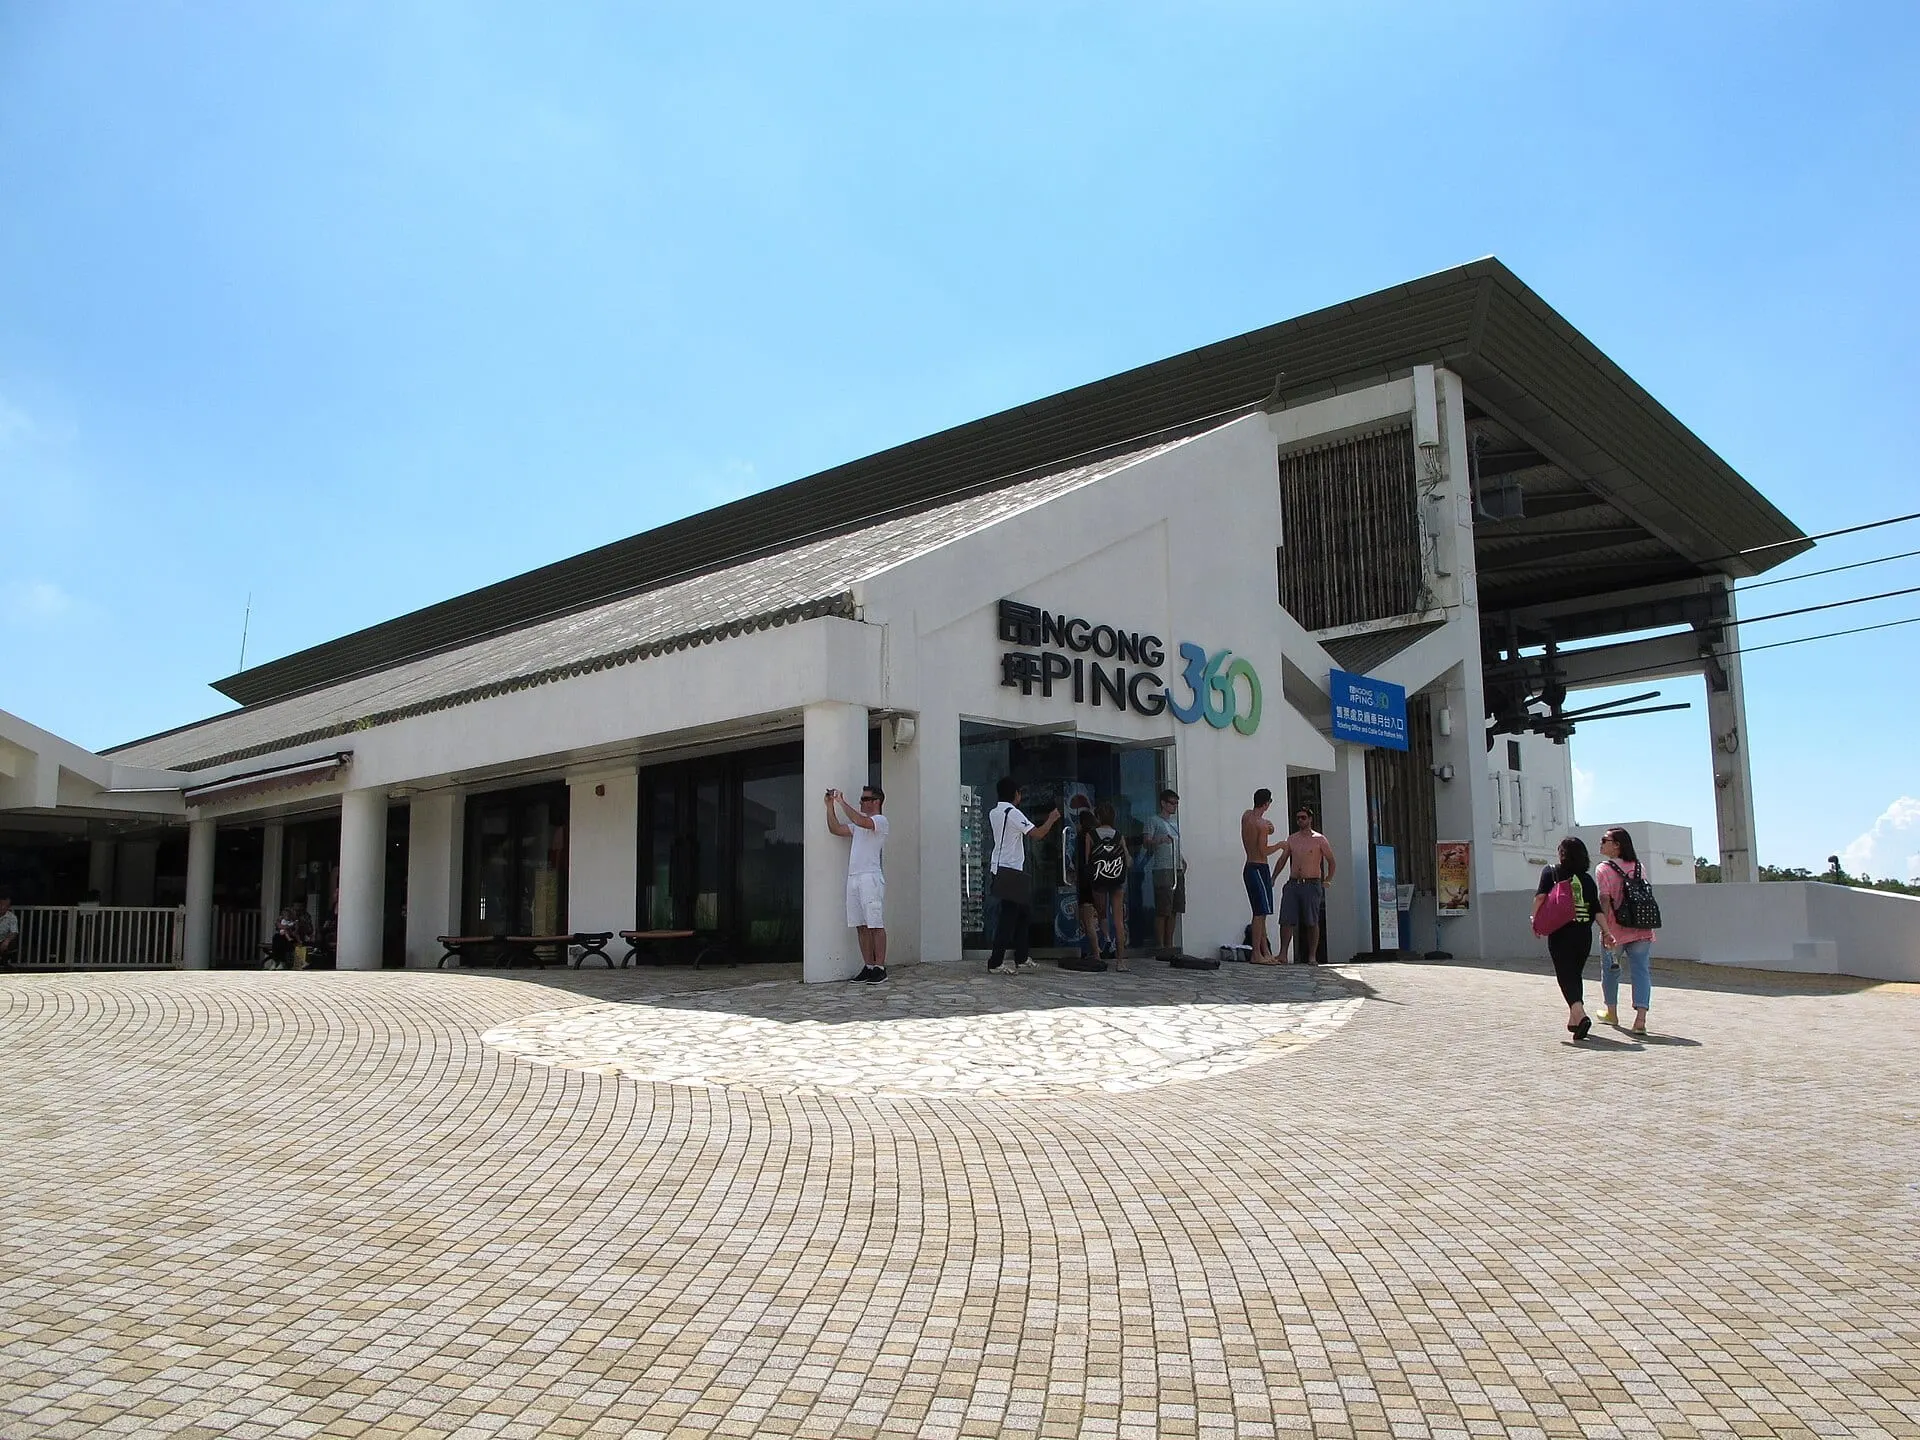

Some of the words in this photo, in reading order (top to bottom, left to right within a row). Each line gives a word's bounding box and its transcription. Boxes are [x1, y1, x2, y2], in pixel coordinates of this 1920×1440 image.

[1041, 610, 1166, 669] NGONG
[1042, 651, 1168, 717] PING
[1164, 642, 1263, 736] 360
